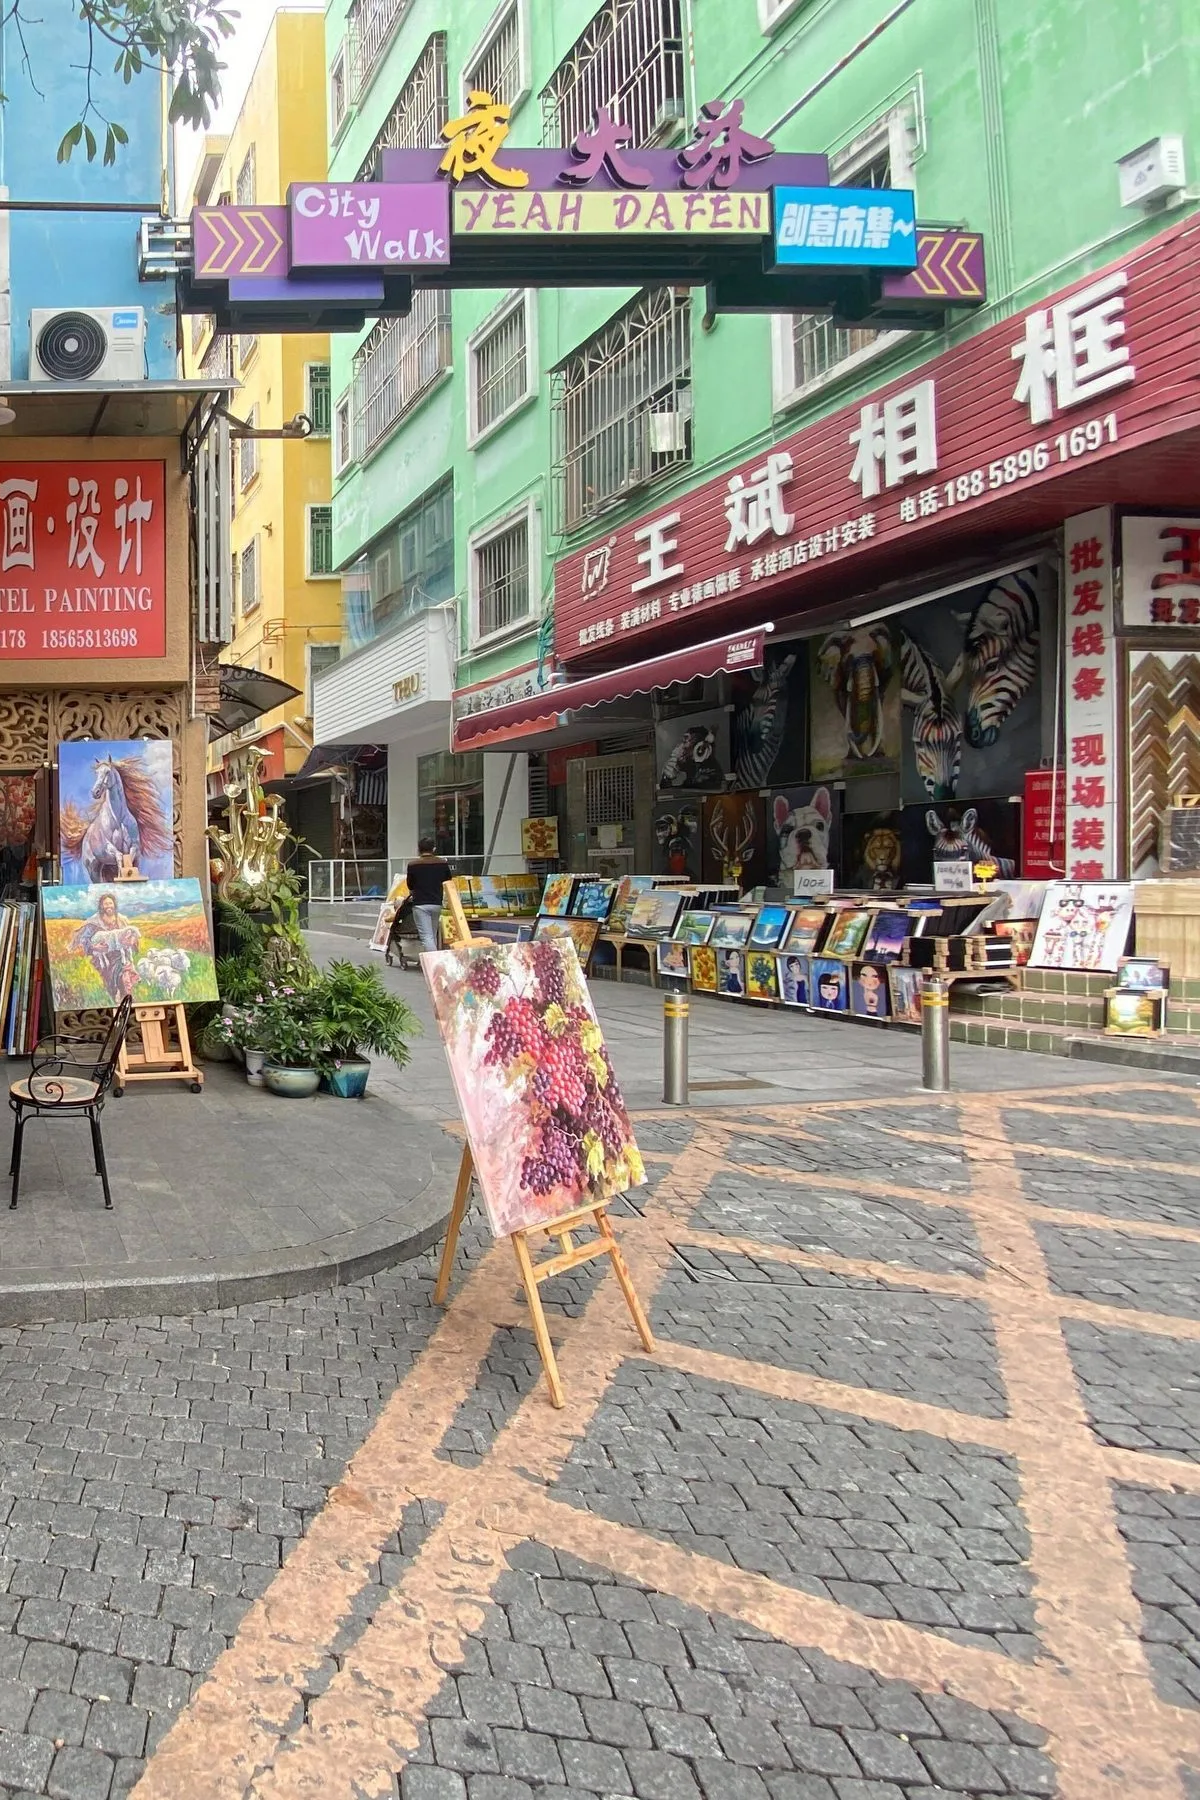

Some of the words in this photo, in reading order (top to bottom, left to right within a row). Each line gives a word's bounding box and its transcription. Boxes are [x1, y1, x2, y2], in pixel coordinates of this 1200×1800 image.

[436, 90, 776, 190] 夜大芬
[295, 187, 380, 228] City
[461, 192, 583, 232] YEAH
[612, 192, 762, 232] DAFEN
[344, 229, 445, 260] Walk
[632, 270, 1137, 592] 王斌相框
[944, 470, 985, 506] 188
[987, 442, 1050, 489] 5896
[1054, 412, 1119, 462] 1691
[44, 586, 153, 612] PAINTING
[1070, 537, 1105, 700] 批发线条
[41, 628, 138, 648] 18565813698
